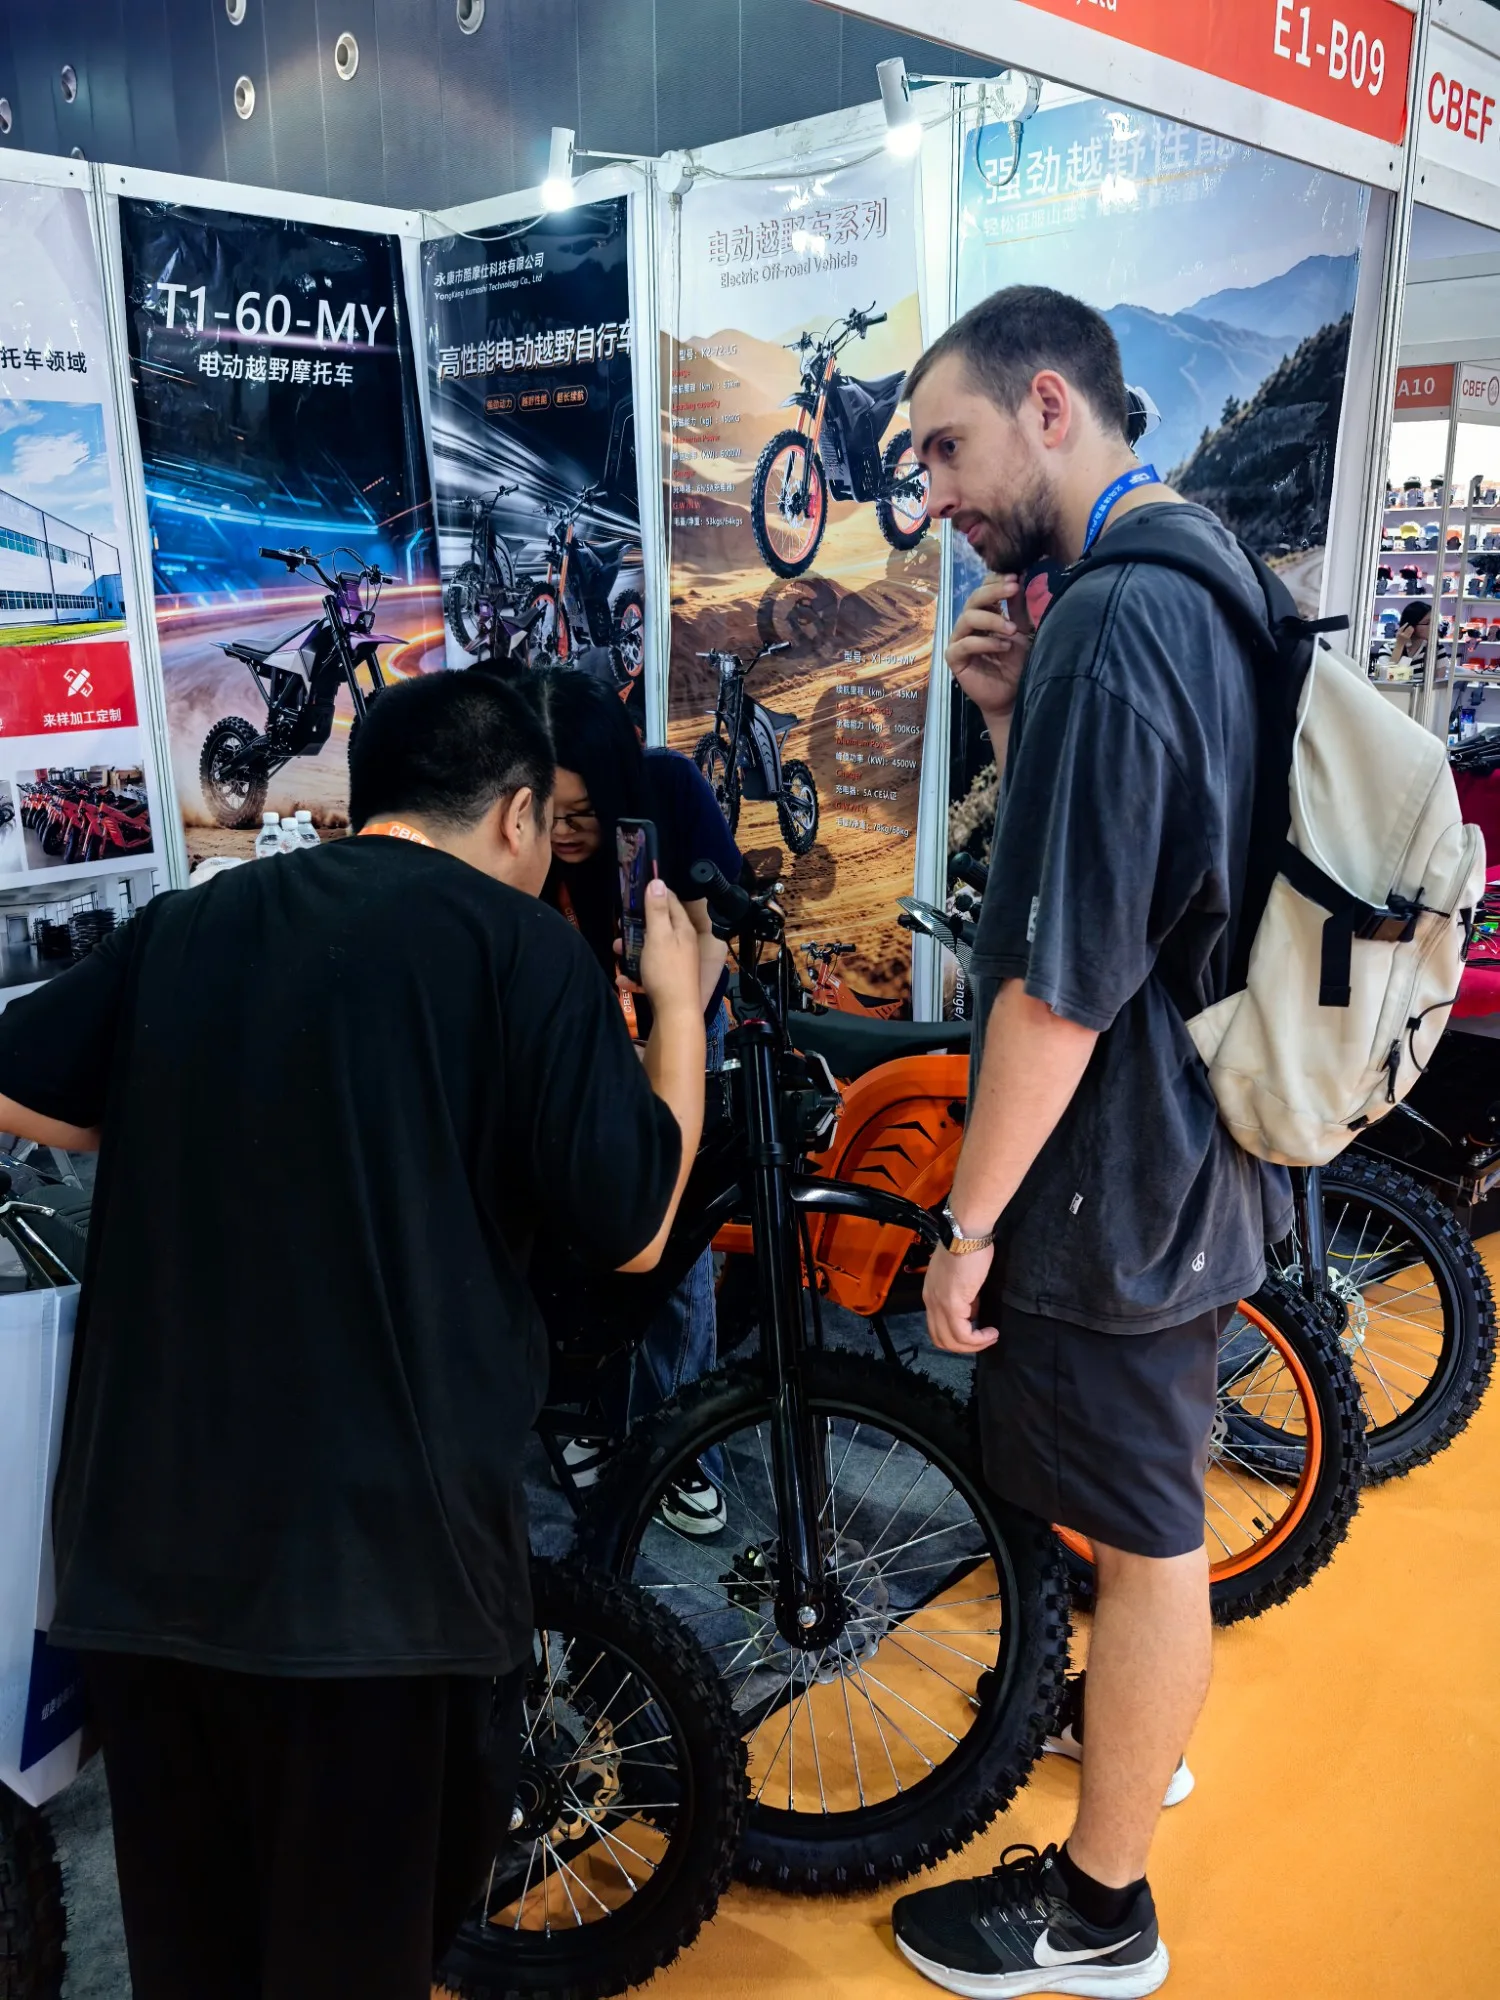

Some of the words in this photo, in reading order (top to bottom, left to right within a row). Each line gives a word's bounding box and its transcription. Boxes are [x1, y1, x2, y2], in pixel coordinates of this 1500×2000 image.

[1273, 0, 1385, 96] E1-B09
[1428, 71, 1496, 144] CBEF
[489, 279, 519, 292] Technology
[720, 266, 759, 289] Electric
[762, 257, 811, 282] Off-road
[814, 250, 858, 275] Vehicle
[156, 282, 388, 347] T1-60-MY
[0, 346, 88, 374] 托车领域
[437, 319, 632, 380] 高性能电动越野自行车
[198, 351, 354, 388] 电动越野摩托车
[1397, 377, 1436, 397] A10
[1462, 378, 1487, 397] CBEF
[43, 708, 122, 728] 来样加工定制
